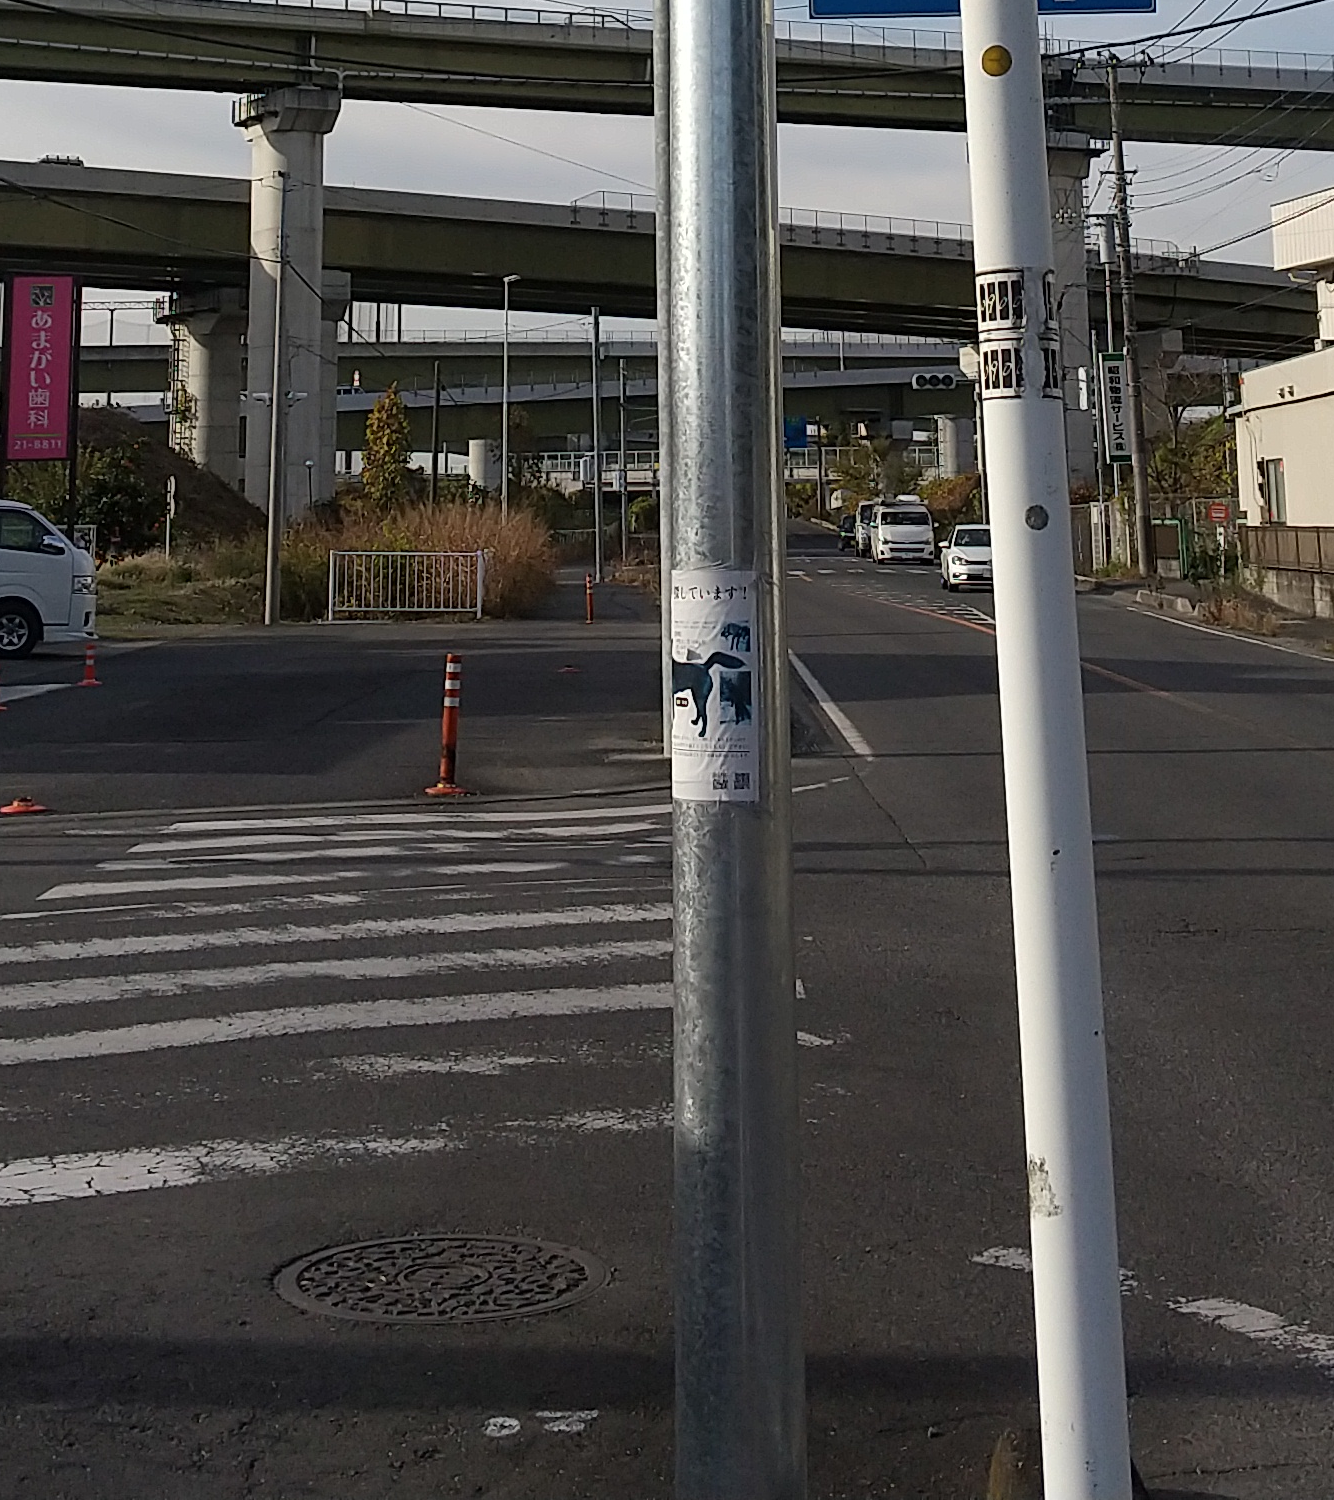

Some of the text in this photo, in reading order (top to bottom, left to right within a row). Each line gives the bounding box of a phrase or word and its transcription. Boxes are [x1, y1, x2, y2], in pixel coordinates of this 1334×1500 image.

[26, 310, 53, 430] あまがい歯科
[13, 439, 63, 450] 21-8811
